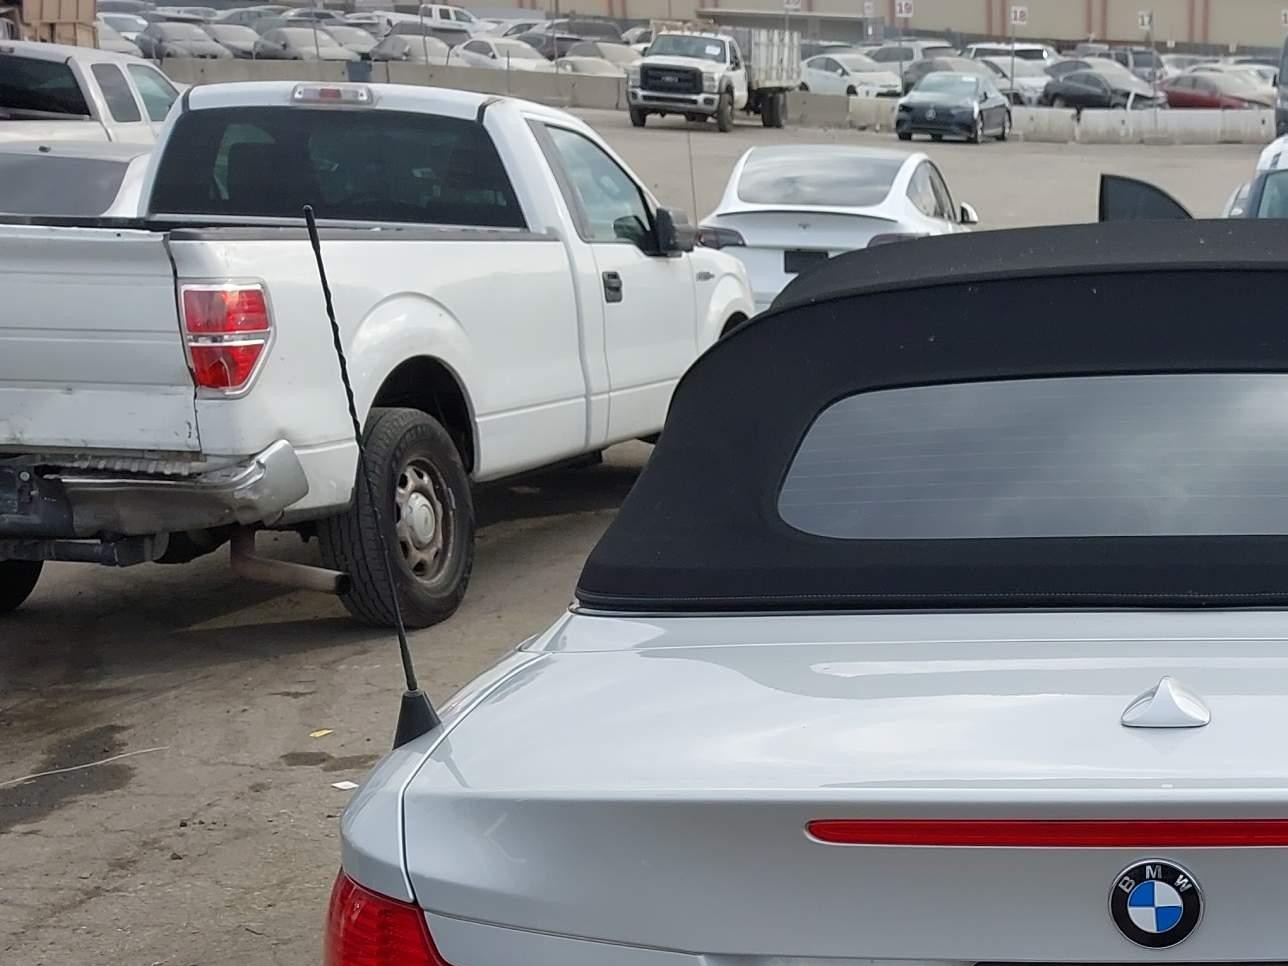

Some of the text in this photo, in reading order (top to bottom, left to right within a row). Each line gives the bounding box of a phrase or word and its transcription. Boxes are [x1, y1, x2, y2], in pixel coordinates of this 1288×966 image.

[897, 2, 912, 14] 19
[1012, 10, 1026, 22] 18
[1118, 864, 1193, 894] BMW
